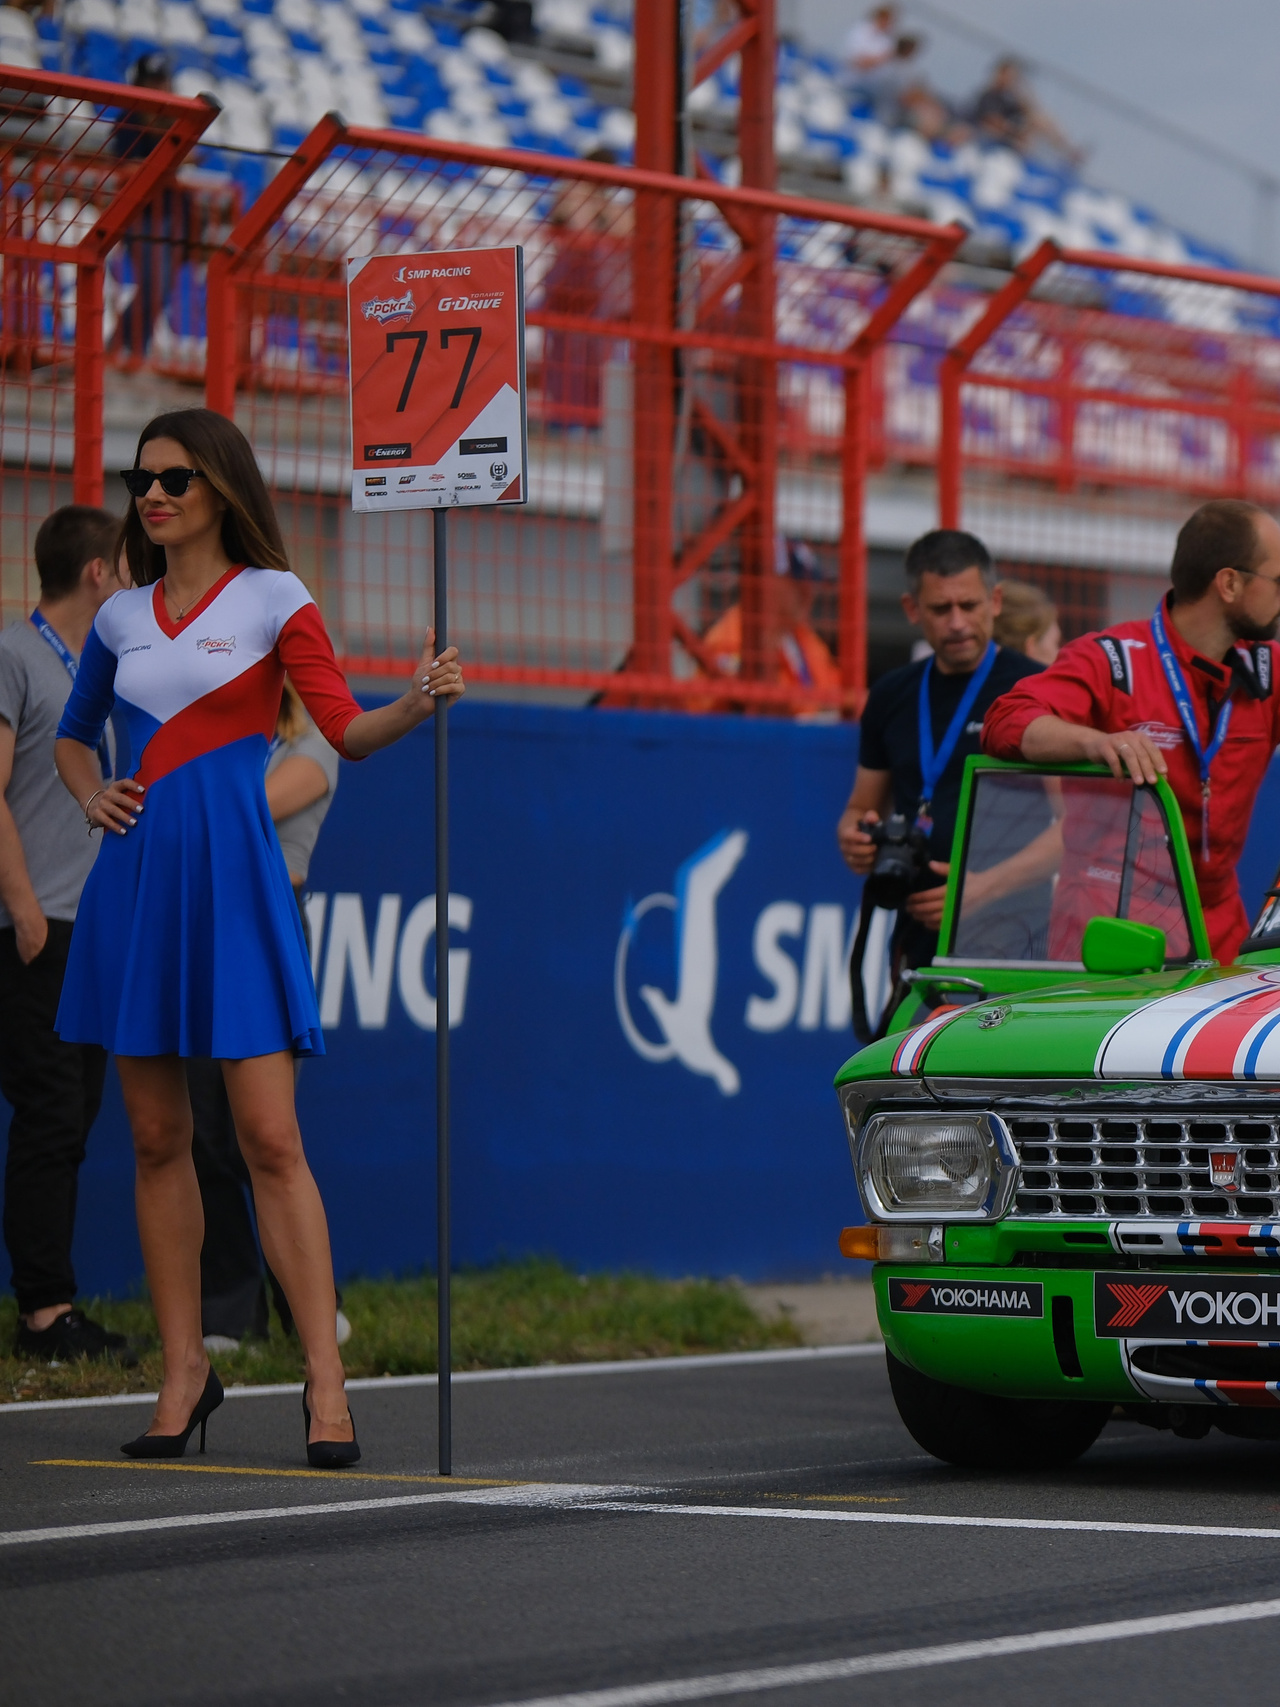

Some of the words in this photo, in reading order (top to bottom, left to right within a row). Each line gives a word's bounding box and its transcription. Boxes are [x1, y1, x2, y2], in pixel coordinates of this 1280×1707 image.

[407, 269, 430, 279] SMP
[431, 266, 471, 278] RACING
[374, 302, 406, 314] РСКГ
[386, 327, 482, 412] 77
[1100, 638, 1124, 681] sparco
[744, 899, 898, 1035] SM
[930, 1287, 1032, 1309] YOKOHAMA
